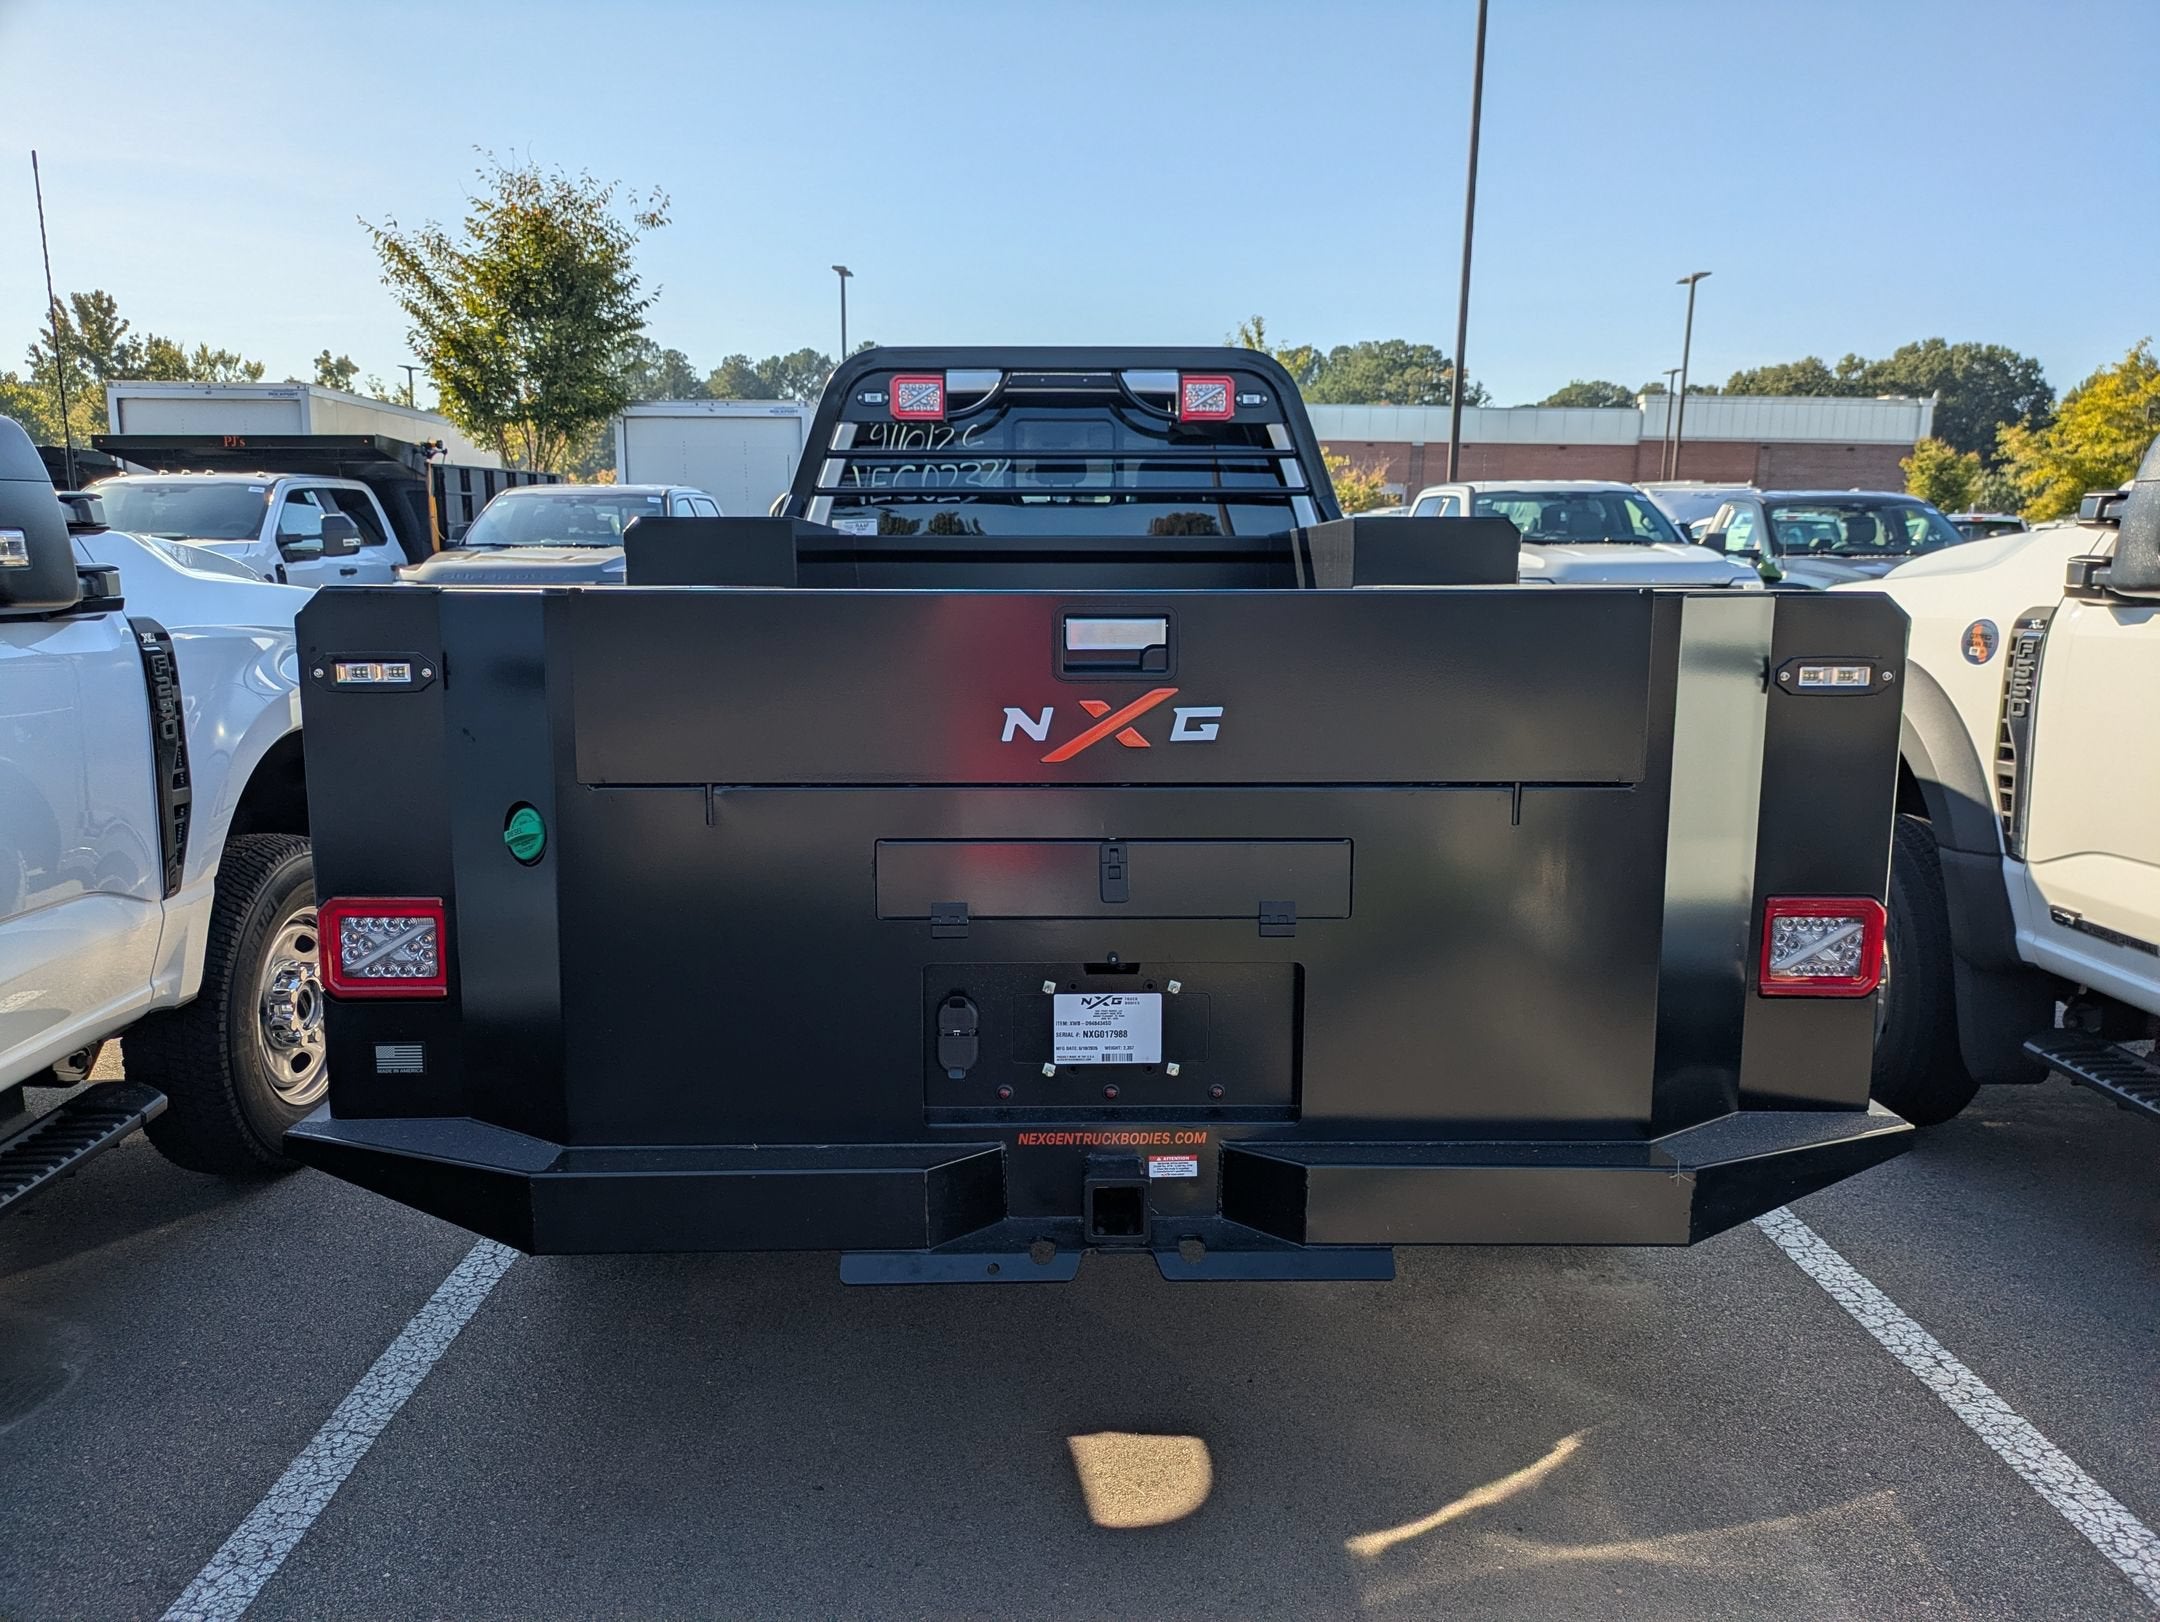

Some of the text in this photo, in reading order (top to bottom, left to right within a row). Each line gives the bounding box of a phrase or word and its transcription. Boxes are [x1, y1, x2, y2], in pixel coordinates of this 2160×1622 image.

[223, 435, 247, 448] PJ's
[1001, 687, 1224, 763] NXG
[1080, 995, 1123, 1010] NXG
[1082, 1029, 1128, 1039] NXG017988
[1018, 1131, 1208, 1146] NEXGENTRUCKBODIES.COM
